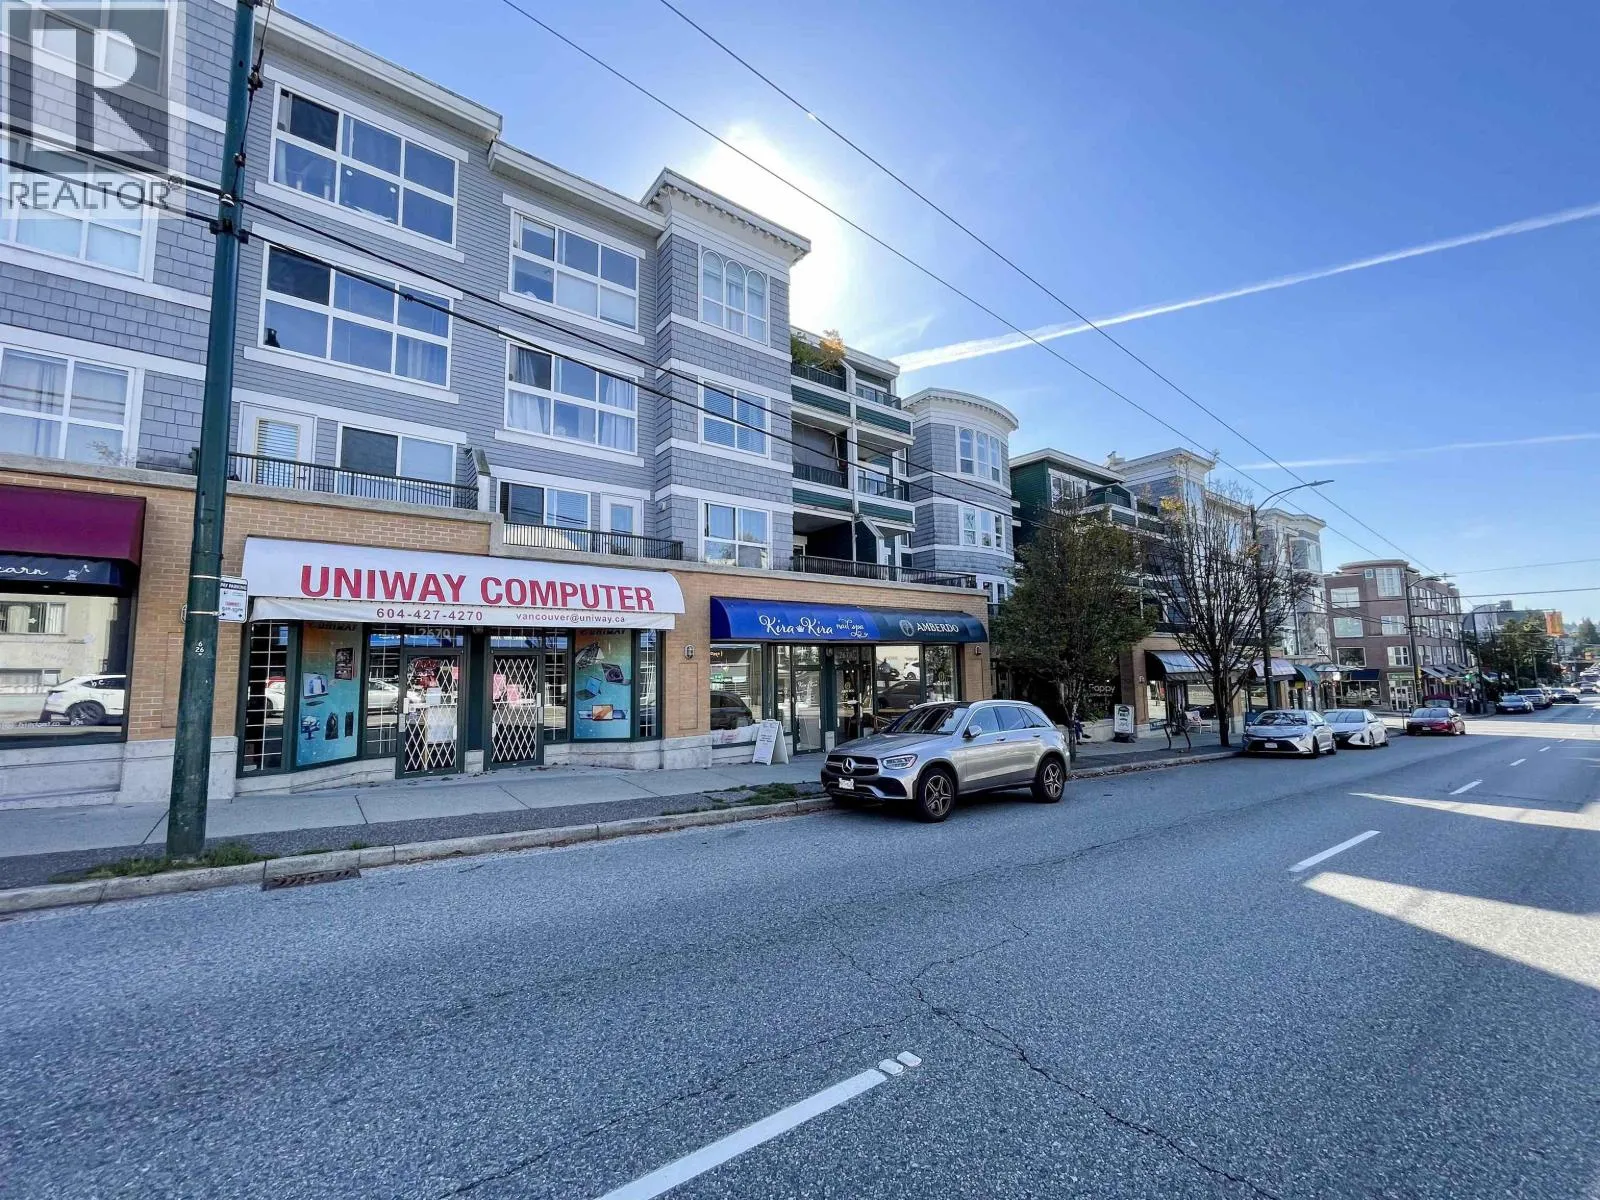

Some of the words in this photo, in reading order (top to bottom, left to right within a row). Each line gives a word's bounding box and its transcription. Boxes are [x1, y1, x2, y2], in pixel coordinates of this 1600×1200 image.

[301, 565, 467, 603] UNIWAY
[480, 576, 655, 611] COMPUTER
[376, 608, 483, 621] 604-427-4270
[516, 612, 625, 624] vancouver@uniway.ca
[759, 614, 795, 636] Kira
[800, 616, 834, 637] Kira
